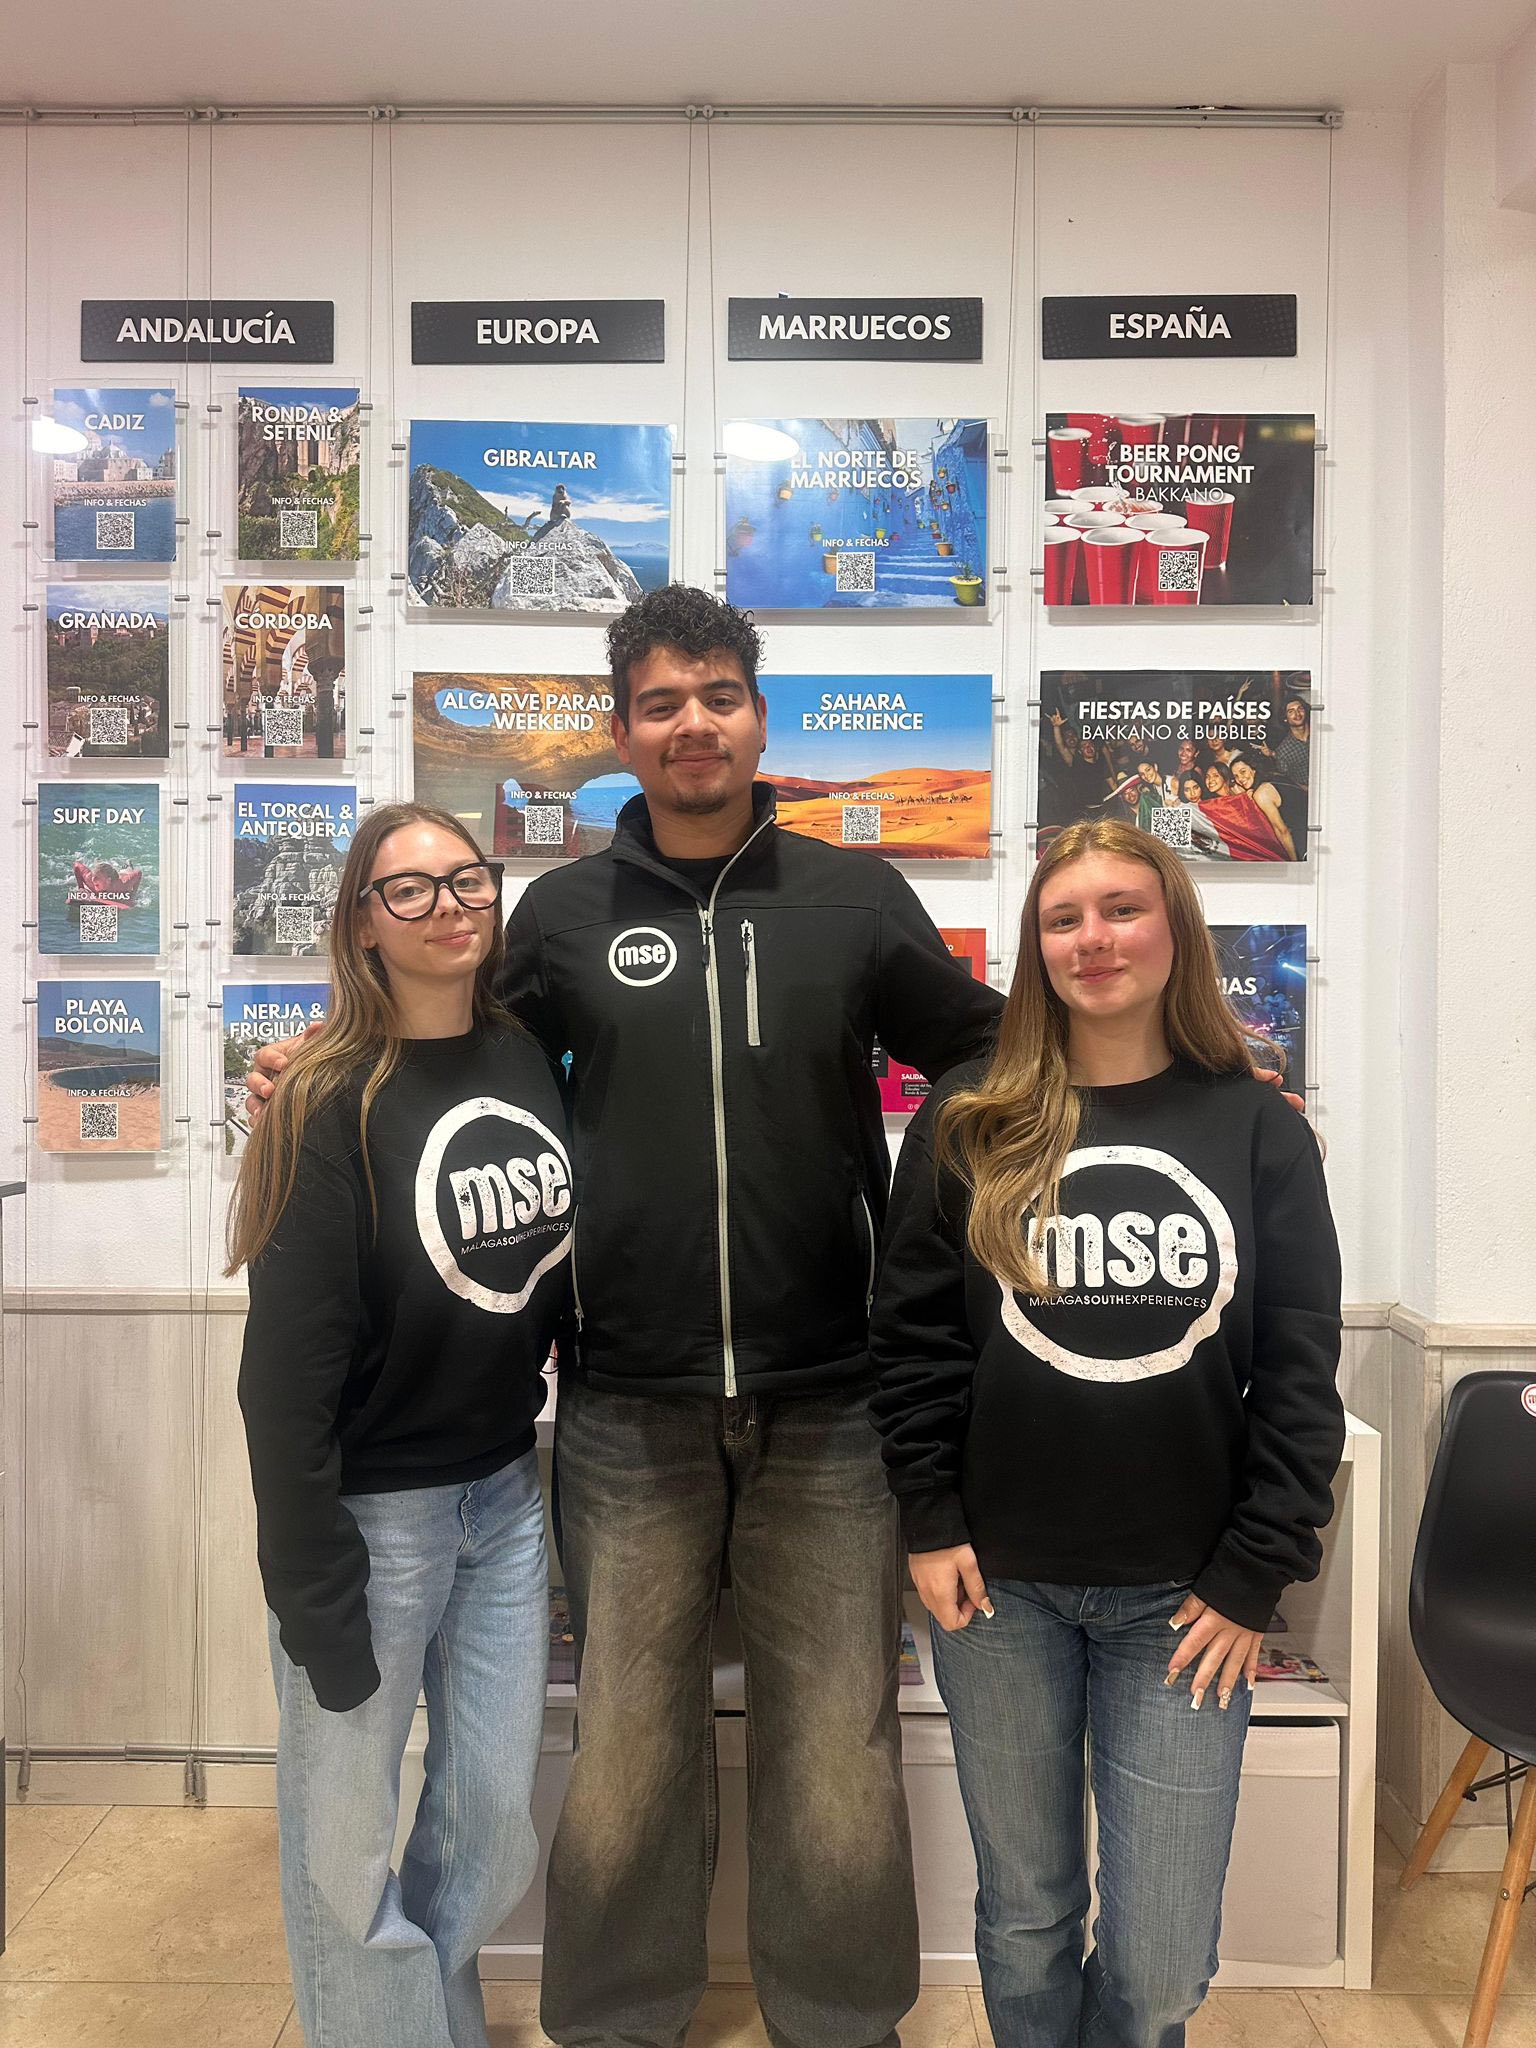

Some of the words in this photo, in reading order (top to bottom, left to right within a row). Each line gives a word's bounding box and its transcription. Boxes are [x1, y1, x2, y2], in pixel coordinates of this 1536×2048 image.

[116, 310, 296, 344] ANDALUCÍA
[476, 318, 600, 345] EUROPA
[759, 314, 951, 340] MARRUECOS
[1109, 306, 1231, 339] ESPAÑA
[84, 414, 145, 431] CADIZ
[251, 406, 322, 423] RONDA
[329, 406, 344, 423] &
[262, 424, 337, 441] SETENIL
[483, 449, 597, 470] GIBRALTAR
[791, 452, 812, 469] EL
[818, 451, 886, 469] NORTE
[893, 451, 917, 468] DE
[1120, 444, 1171, 463] BEER
[1176, 444, 1240, 463] PONG
[790, 470, 922, 489] MARRUECOS
[1105, 464, 1255, 484] TOURNAMENT
[84, 499, 105, 507] INFO
[106, 499, 114, 507] &
[115, 499, 147, 507] FECHAS
[272, 497, 293, 505] INFO
[294, 497, 302, 505] &
[302, 497, 334, 505] FECHAS
[1135, 487, 1224, 502] BAKKANO
[505, 541, 527, 549] INFO
[530, 541, 537, 549] &
[538, 542, 573, 550] FECHAS
[822, 539, 844, 547] INFO
[846, 539, 854, 547] &
[855, 539, 889, 547] FECHAS
[58, 612, 157, 630] GRANADA
[235, 608, 333, 630] CÓRDOBA
[77, 695, 98, 703] INFO
[99, 695, 107, 703] &
[108, 695, 140, 703] FECHAS
[252, 695, 273, 704] INFO
[275, 695, 282, 704] &
[283, 695, 315, 704] FECHAS
[442, 692, 540, 711] ALGARVE
[546, 693, 615, 712] PARAD
[820, 693, 906, 711] SAHARA
[1078, 701, 1161, 720] FIESTAS
[1166, 701, 1193, 720] DE
[1198, 695, 1271, 720] PAÍSES
[493, 713, 594, 731] WEEKEND
[802, 713, 923, 731] EXPERIENCE
[1082, 724, 1172, 740] BAKKANO
[1176, 724, 1190, 740] &
[1194, 724, 1267, 740] BUBBLES
[511, 791, 532, 799] INFO
[534, 791, 542, 799] &
[543, 791, 577, 799] FECHAS
[828, 792, 850, 800] INFO
[852, 792, 859, 800] &
[861, 792, 895, 800] FECHAS
[52, 808, 101, 825] SURF
[106, 808, 145, 825] DAY
[238, 802, 257, 818] EL
[261, 802, 335, 820] TORCAL
[339, 803, 354, 820] &
[240, 820, 350, 838] ANTEQUERA
[67, 892, 89, 900] INFO
[90, 892, 97, 900] &
[98, 892, 130, 900] FECHAS
[257, 892, 278, 900] INFO
[280, 892, 288, 900] &
[288, 892, 321, 900] FECHAS
[618, 943, 667, 967] mse
[66, 999, 128, 1016] PLAYA
[243, 1003, 305, 1020] NERJA
[309, 1002, 326, 1019] &
[55, 1017, 144, 1034] BOLONIA
[230, 1021, 323, 1039] FRIGILIA
[68, 1089, 89, 1097] INFO
[90, 1089, 97, 1097] &
[98, 1089, 131, 1097] FECHAS
[449, 1152, 571, 1240] mse
[1028, 1211, 1208, 1289] mse
[1029, 1294, 1207, 1309] MALAGASOUTHEXPERIENCES
